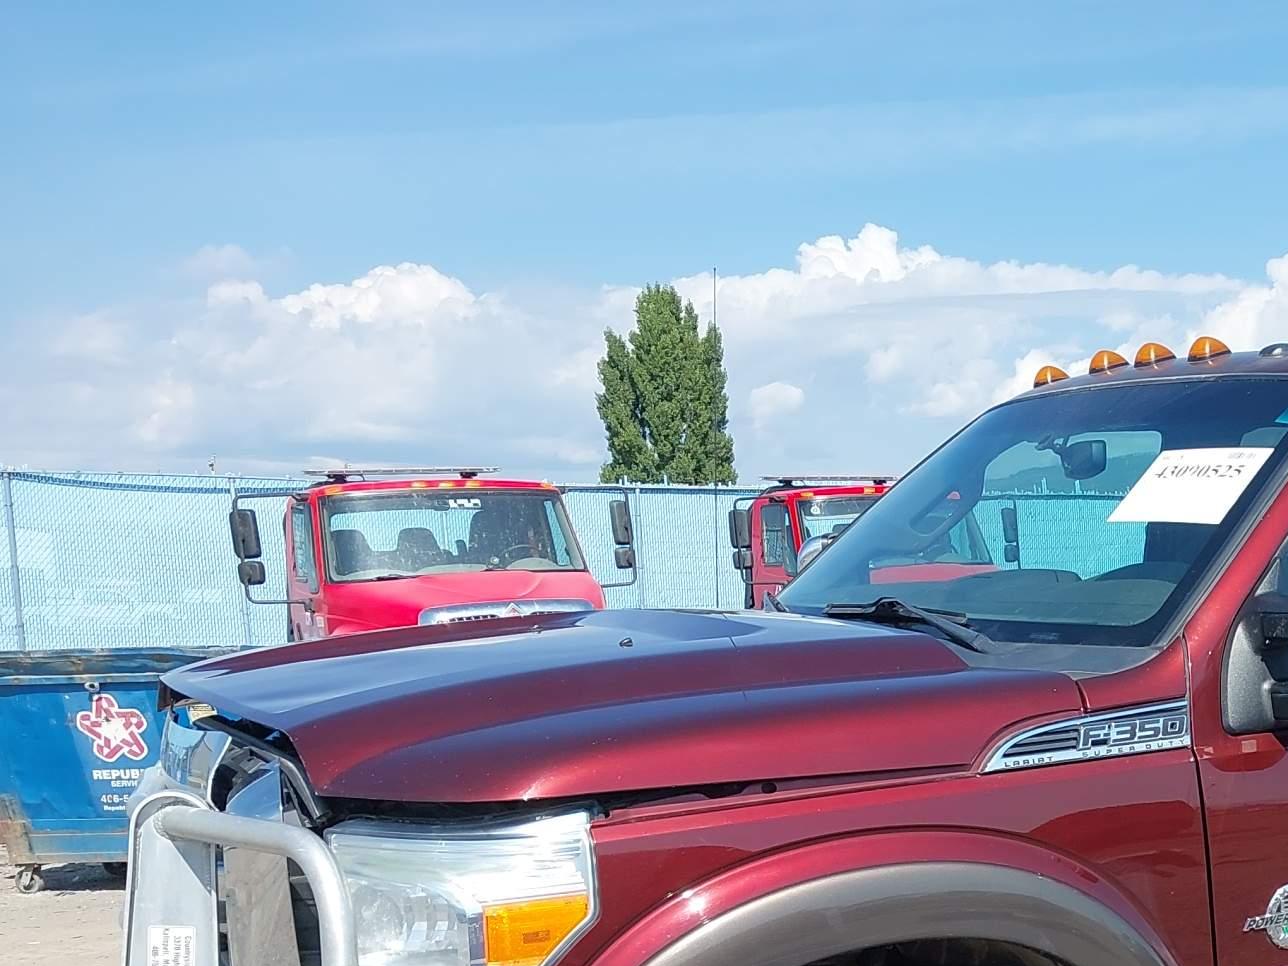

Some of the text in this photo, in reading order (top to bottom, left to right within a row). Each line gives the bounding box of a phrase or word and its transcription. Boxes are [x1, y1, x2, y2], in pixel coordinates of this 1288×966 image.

[1153, 464, 1246, 478] 43090525
[1078, 715, 1187, 751] F-350
[1081, 738, 1186, 758] SUPER DUTY
[1004, 755, 1054, 768] LARIAT
[101, 794, 129, 803] 406-5
